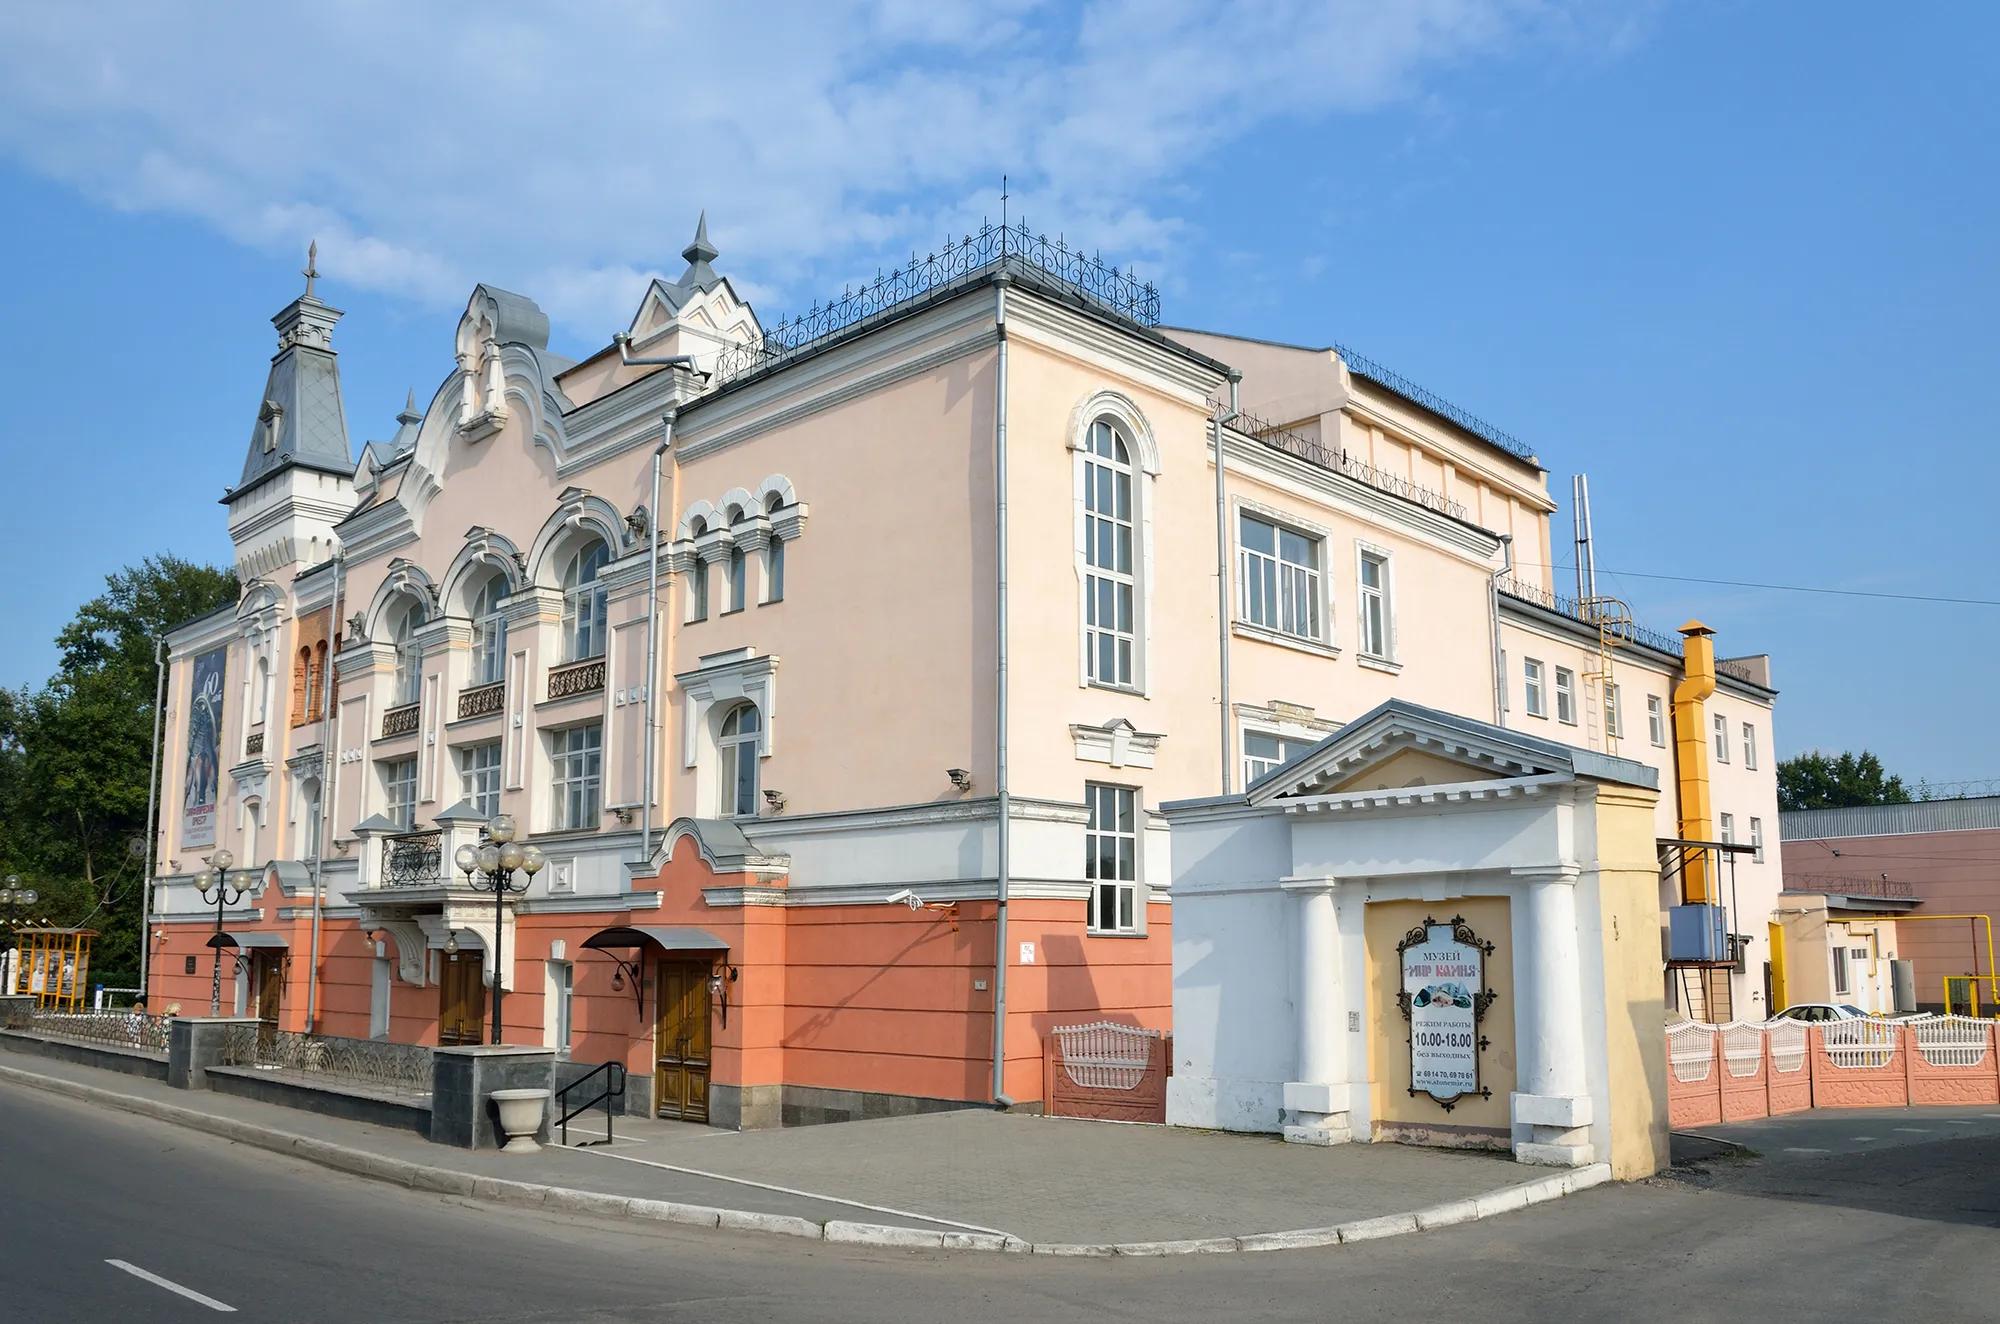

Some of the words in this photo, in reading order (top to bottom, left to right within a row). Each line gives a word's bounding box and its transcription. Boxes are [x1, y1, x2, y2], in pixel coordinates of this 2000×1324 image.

[203, 671, 219, 698] 60
[1423, 950, 1461, 961] МУЗЕЙ
[1408, 964, 1432, 977] МИР
[1435, 964, 1476, 977] КАМНЯ
[1443, 1021, 1472, 1029] РАБОТЫ
[1415, 1032, 1472, 1048] 10.00-18.00
[1416, 1050, 1430, 1058] без
[1430, 1052, 1472, 1060] выходных
